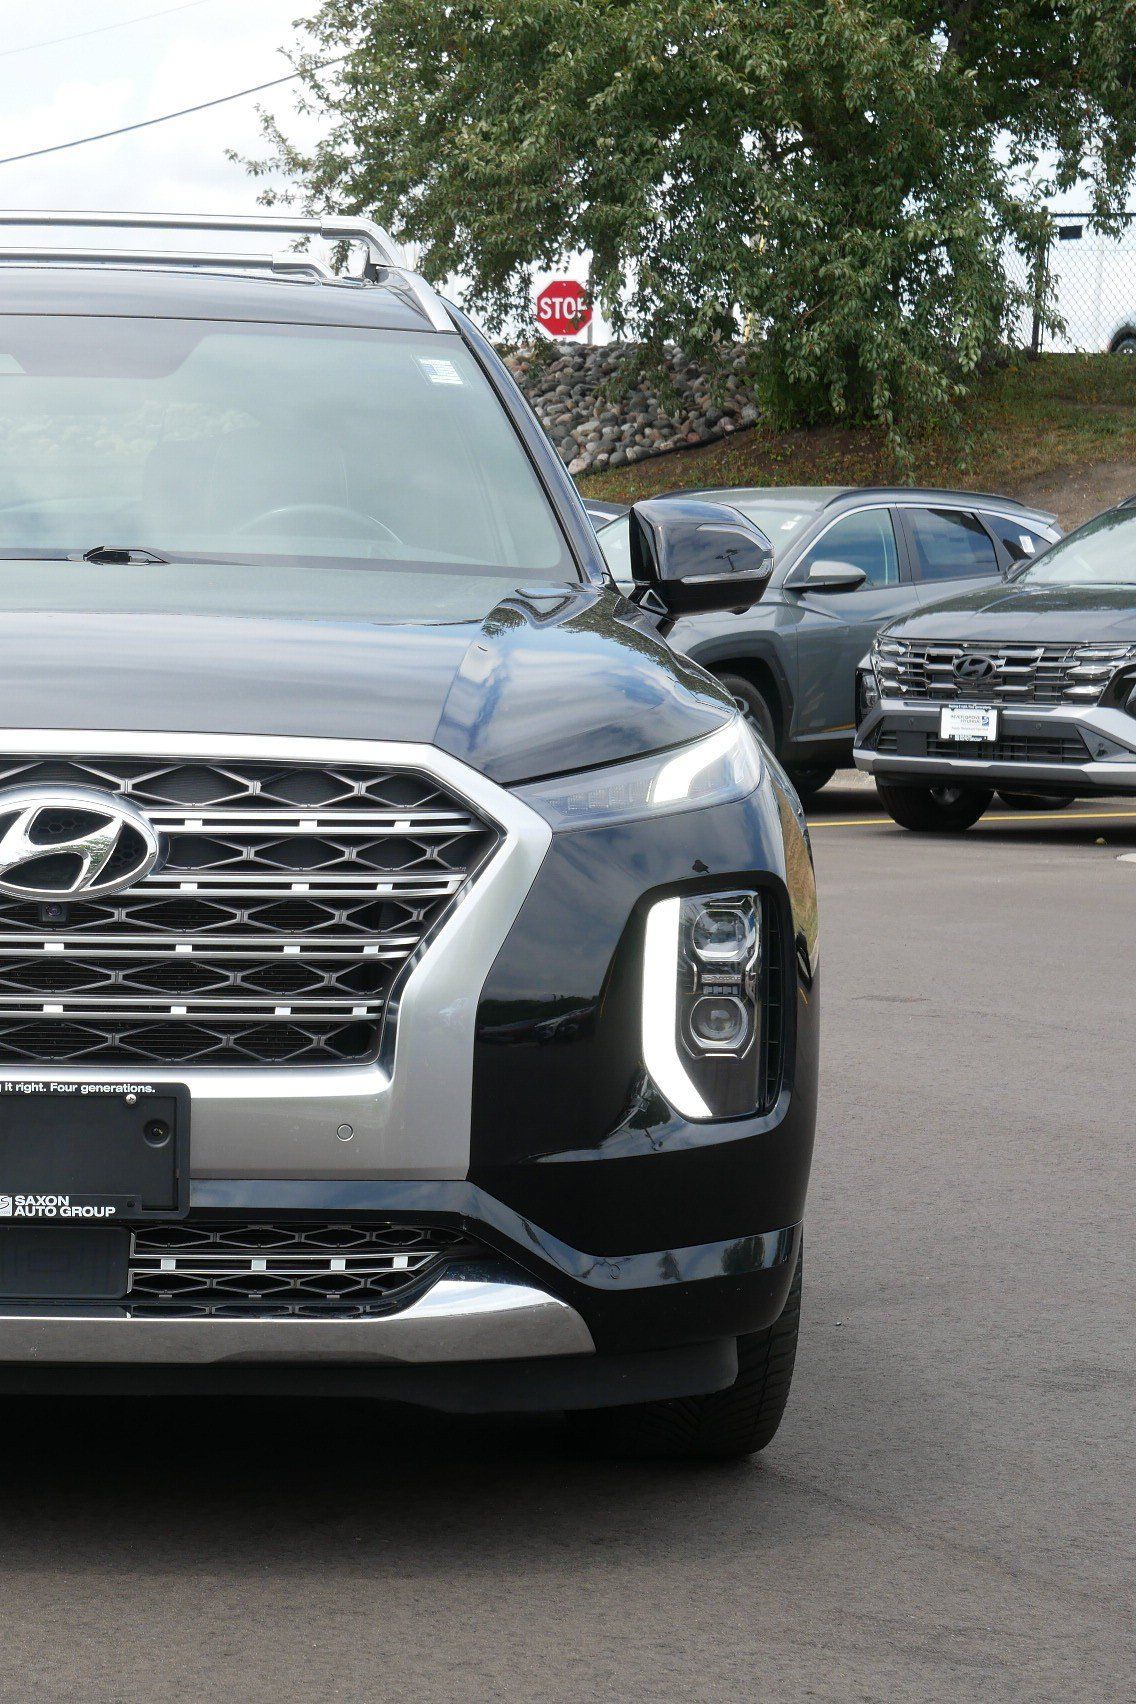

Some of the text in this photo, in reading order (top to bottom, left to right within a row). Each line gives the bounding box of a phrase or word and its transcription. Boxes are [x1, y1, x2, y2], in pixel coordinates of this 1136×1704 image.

[4, 1081, 14, 1092] it
[15, 1081, 47, 1093] right.
[50, 1082, 77, 1093] Four
[80, 1082, 156, 1094] generations.
[13, 1195, 70, 1207] SAXON
[13, 1205, 116, 1218] AUTO GROUP
